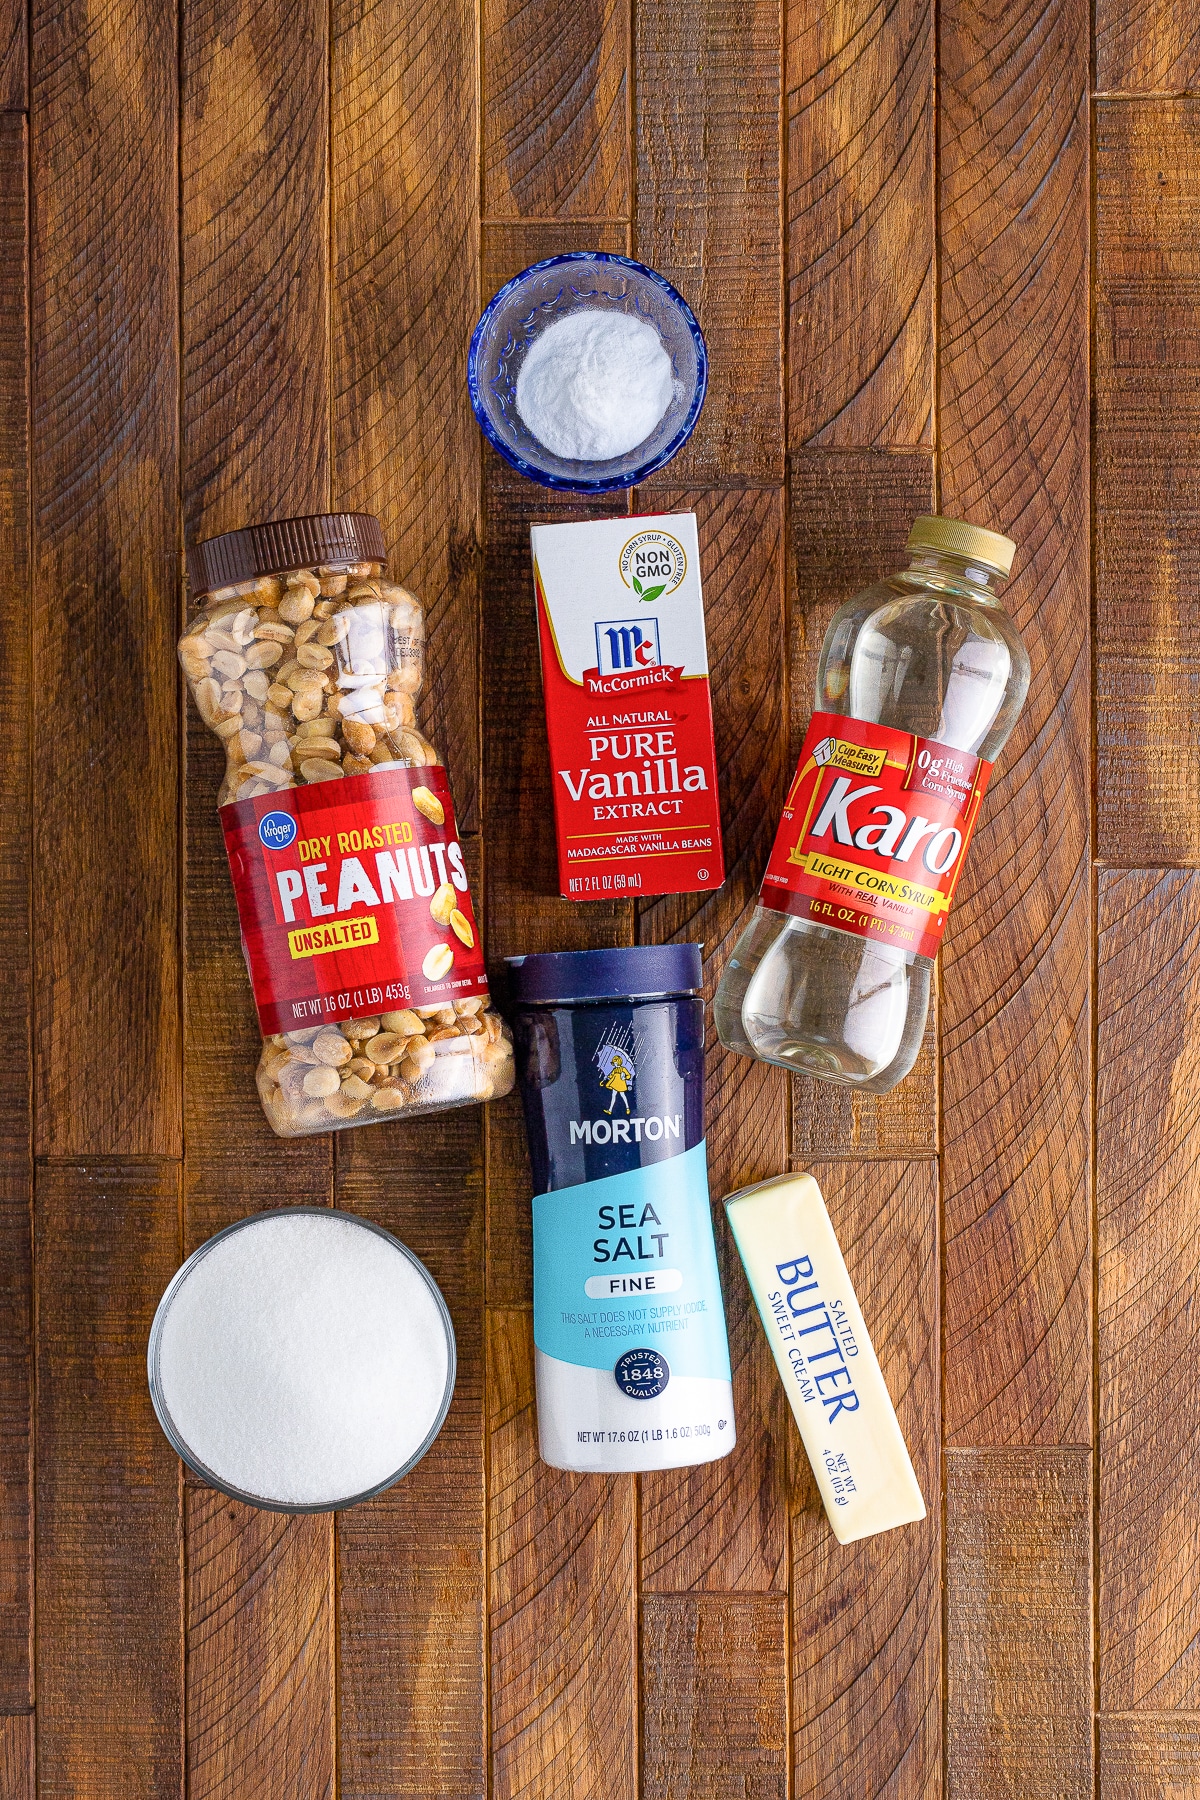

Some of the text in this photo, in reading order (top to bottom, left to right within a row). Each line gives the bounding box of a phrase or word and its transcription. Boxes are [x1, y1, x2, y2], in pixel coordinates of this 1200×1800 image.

[622, 534, 684, 585] NO CORN SYRUP GLUTEN FREE
[636, 551, 670, 564] NON
[636, 564, 672, 578] GMO
[588, 668, 674, 693] McCormick
[587, 710, 672, 727] ALL NATURAL
[589, 731, 677, 761] PURE
[838, 744, 880, 764] Cup Easy
[832, 754, 879, 774] Measure!
[918, 750, 944, 776] 0g
[944, 758, 964, 773] High
[558, 758, 708, 801] Vanilla
[922, 777, 966, 803] Corn Syrup
[941, 770, 972, 790] Fructose
[593, 800, 683, 820] EXTRACT
[264, 819, 291, 842] Kroger
[810, 776, 962, 874] Karo
[298, 822, 412, 862] DRY ROASTED
[568, 838, 712, 858] MADAGASCAR VANILLA BEANS
[616, 834, 662, 844] MADE WITH
[276, 842, 468, 923] PEANUTS
[569, 873, 642, 892] NET 2 FL OZ (59 mL)
[811, 858, 853, 881] LIGHT
[855, 872, 898, 895] CORN
[899, 885, 934, 906] SYRUP
[828, 883, 914, 915] WITH REAL VANILLA
[810, 900, 820, 912] 16
[822, 903, 834, 917] FL.
[838, 908, 855, 923] OZ.
[858, 914, 869, 926] (1
[870, 918, 887, 933] PT.)
[294, 922, 372, 952] UNSALTED
[292, 984, 410, 1019] NET WT 16 OZ (1 LB) 453g
[569, 1116, 680, 1144] MORTON
[598, 1202, 662, 1230] SEA
[593, 1233, 669, 1262] SALT
[610, 1276, 656, 1293] FINE
[561, 1312, 576, 1324] THIS
[577, 1312, 597, 1324] SALT
[600, 1311, 625, 1323] DOES
[628, 1309, 647, 1321] NOT
[650, 1304, 682, 1318] SUPPLY
[584, 1318, 689, 1338] A NECESSARY NUTRIENT
[776, 1254, 860, 1424] BUTTER
[830, 1300, 859, 1357] SALTED
[621, 1352, 661, 1368] TRUSTED
[768, 1292, 816, 1403] SWEET CREAM
[622, 1367, 664, 1381] 1848
[625, 1382, 662, 1396] QUALITY
[577, 1431, 591, 1443] NET
[592, 1431, 606, 1443] WT
[608, 1430, 626, 1442] 17.6
[628, 1430, 639, 1442] OZ
[642, 1430, 649, 1443] (1
[652, 1430, 662, 1440] LB
[666, 1428, 678, 1439] 1.6
[694, 1424, 711, 1437] 500g
[823, 1448, 849, 1506] 4 OZ (113 g)
[836, 1453, 857, 1493] NET WT
